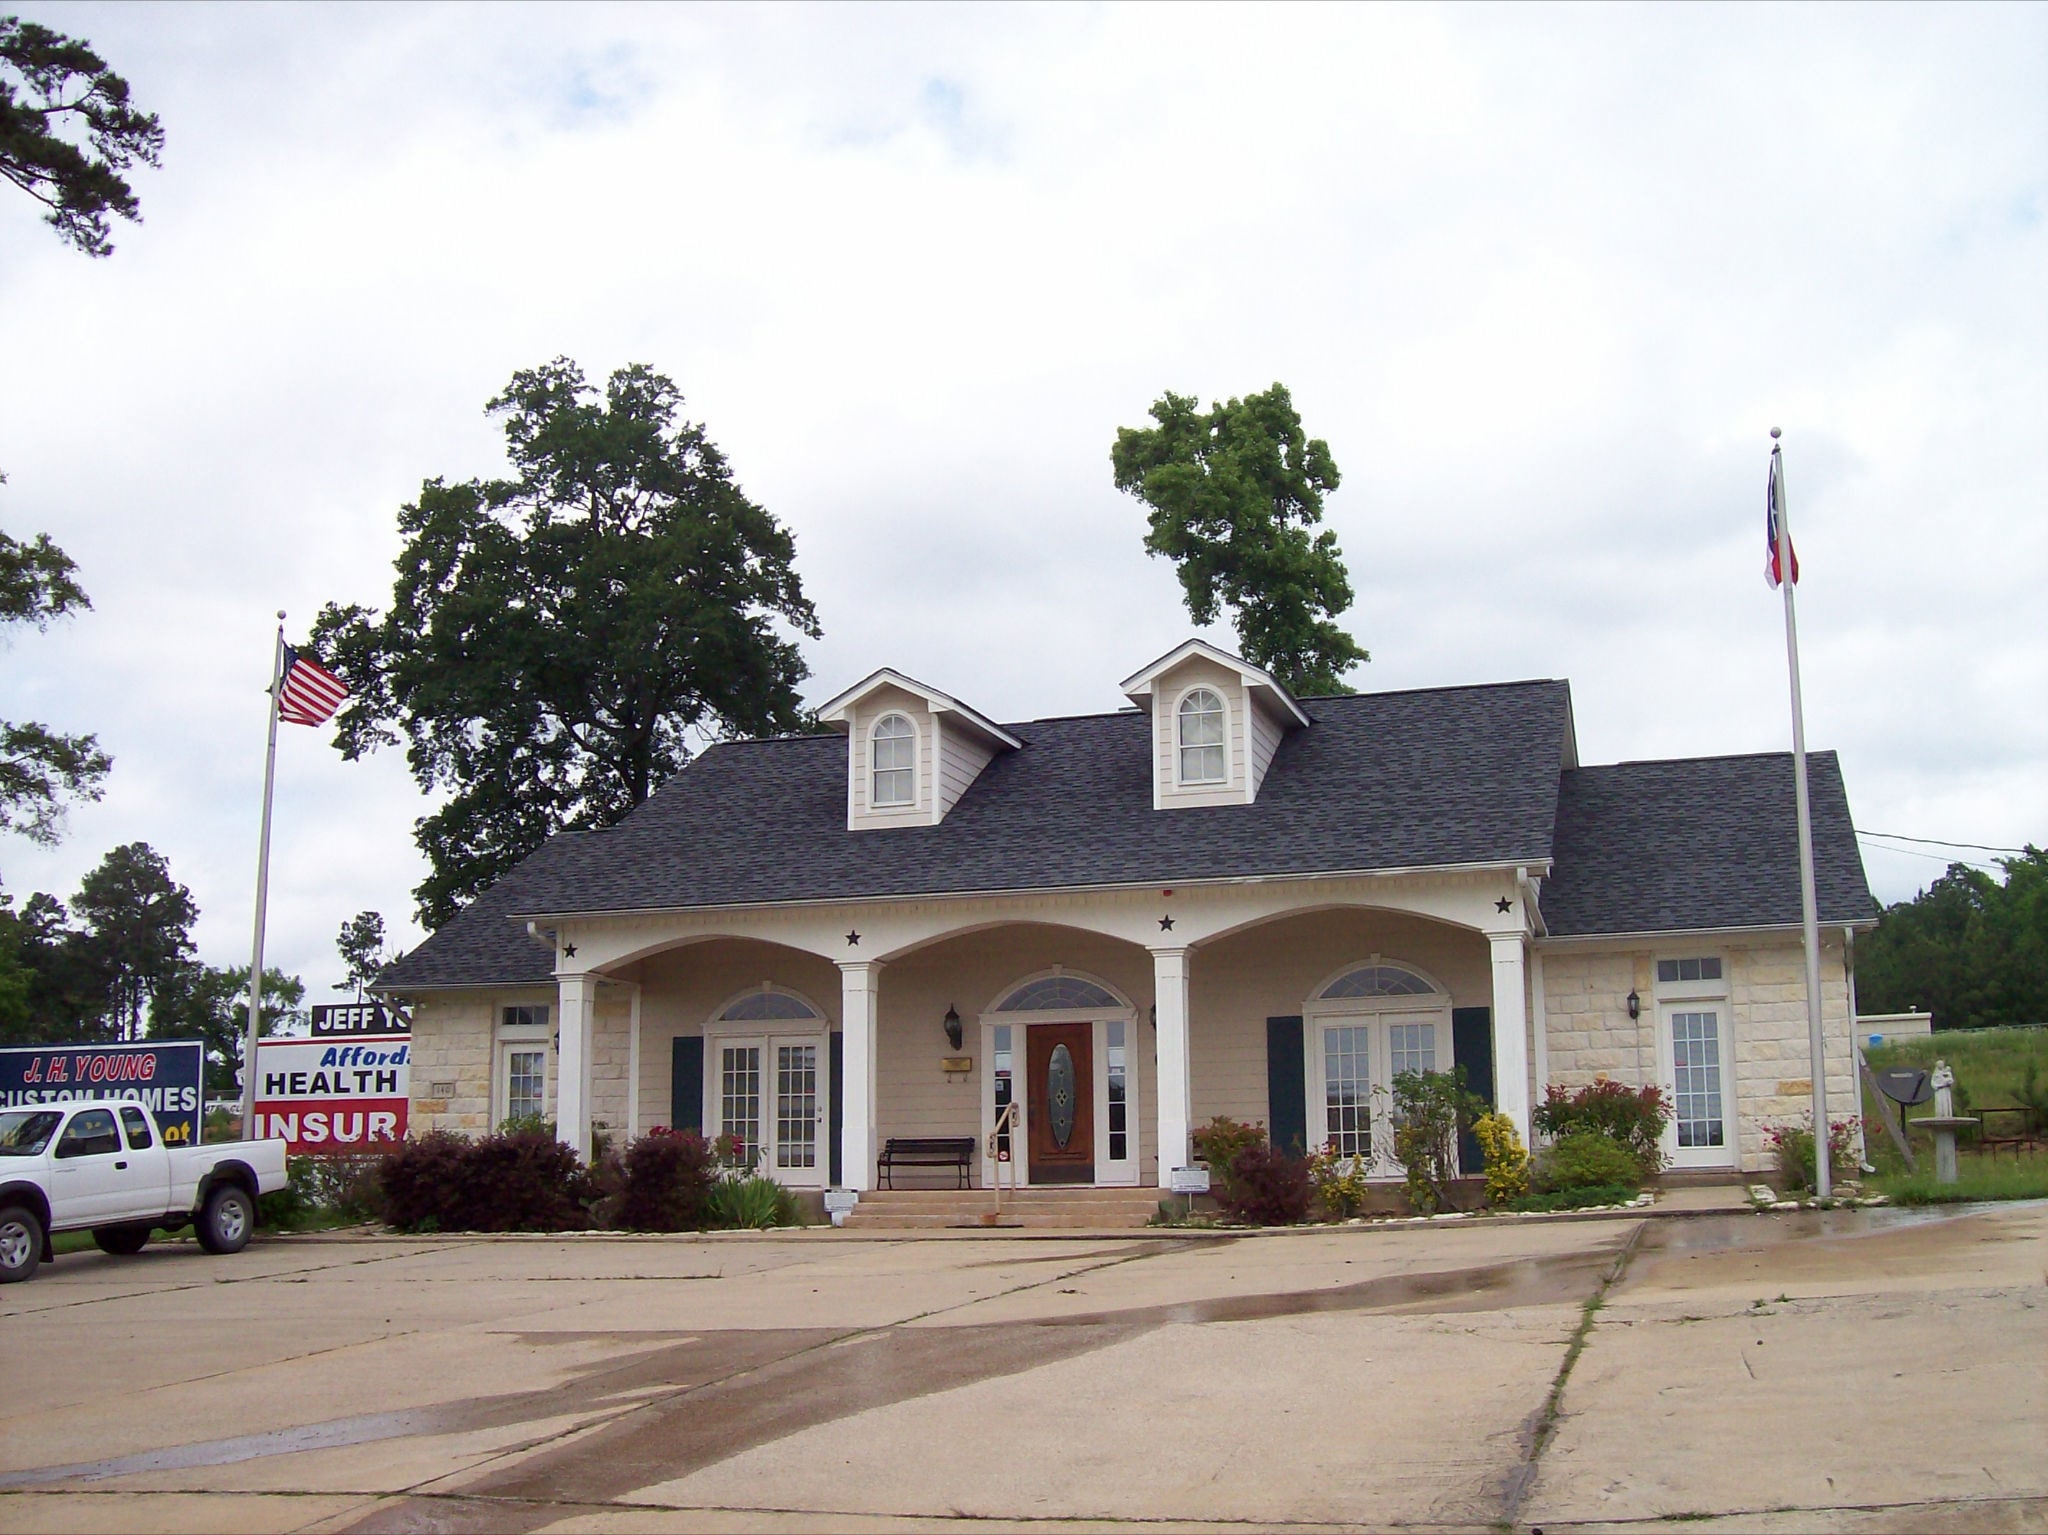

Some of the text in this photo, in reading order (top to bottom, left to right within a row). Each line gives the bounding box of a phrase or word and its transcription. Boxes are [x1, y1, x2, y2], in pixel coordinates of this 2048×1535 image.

[319, 1007, 374, 1030] JEFF
[75, 1053, 156, 1082] YOUNG
[320, 1045, 411, 1067] Afford
[266, 1070, 397, 1095] HEALTH
[255, 1111, 410, 1143] INSUR
